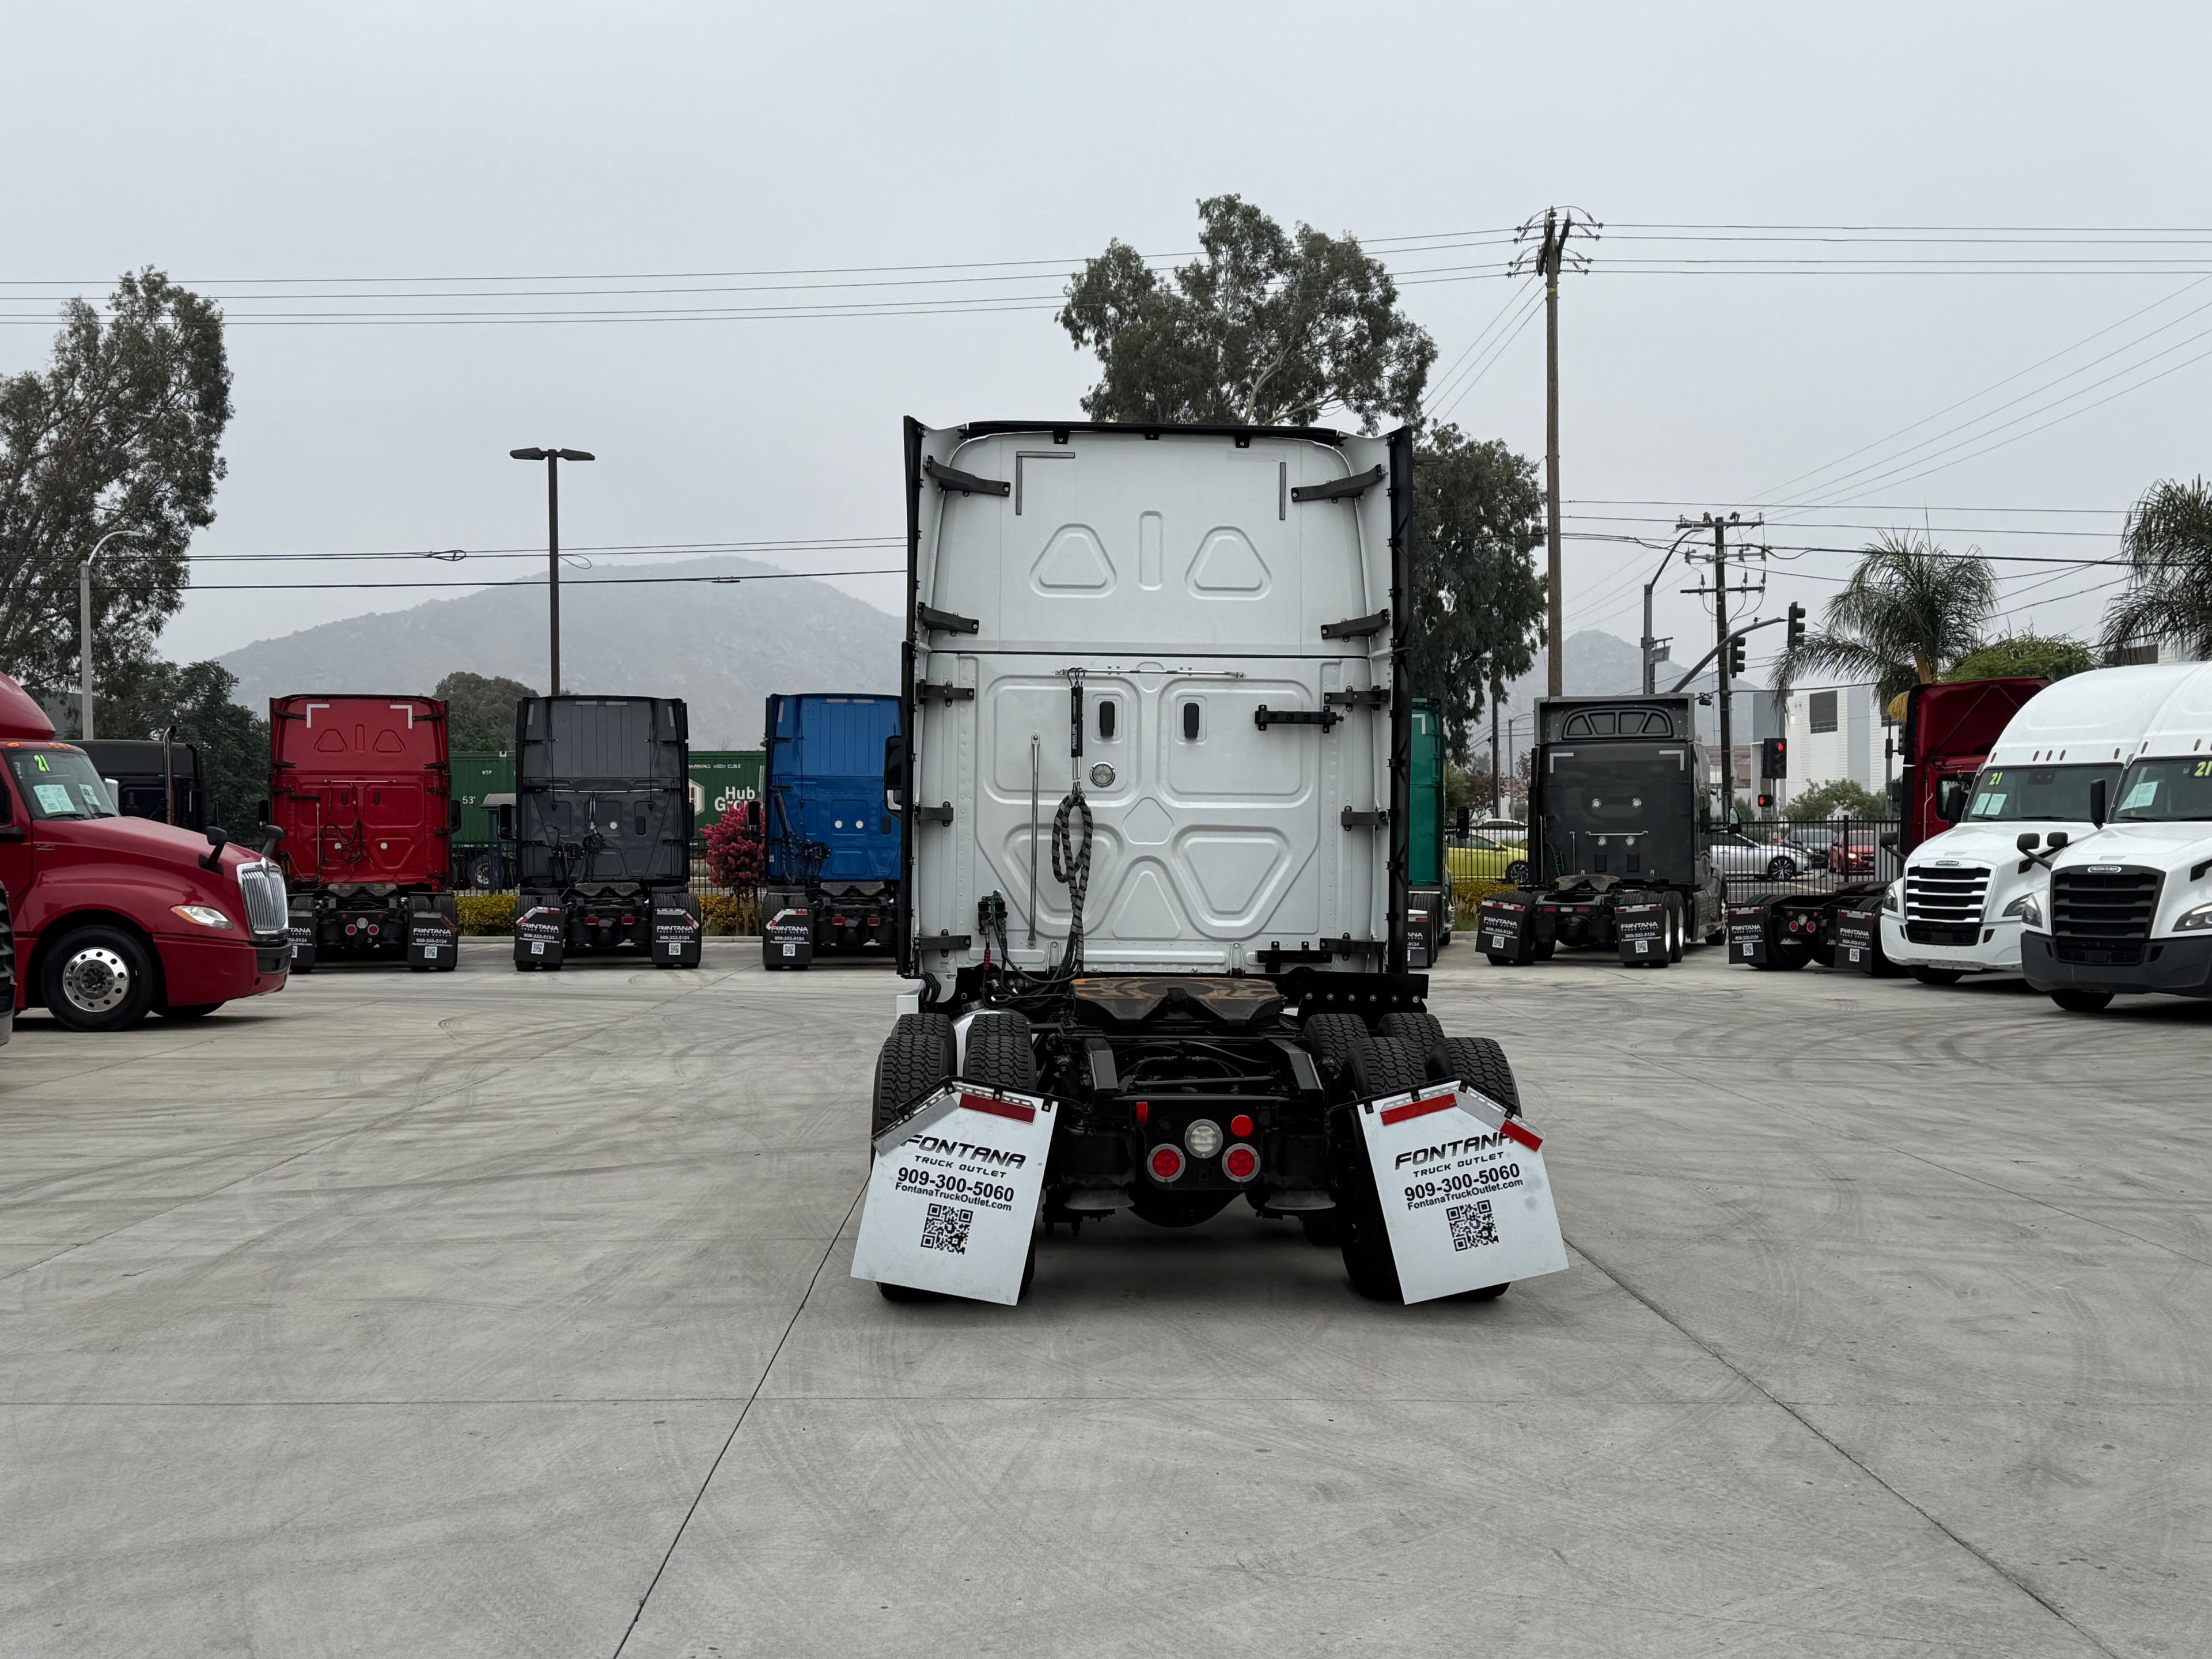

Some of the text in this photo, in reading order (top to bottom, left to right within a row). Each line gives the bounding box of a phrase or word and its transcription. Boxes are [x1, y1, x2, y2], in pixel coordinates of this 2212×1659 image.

[33, 755, 51, 772] 21
[2194, 760, 2212, 777] 21
[1989, 772, 2003, 786] 21
[726, 786, 755, 800] Hub
[521, 923, 559, 931] FONTANA
[900, 1134, 1027, 1169] FONTANA
[915, 1155, 1007, 1178] TRUCK OUTLET
[1413, 1152, 1503, 1177] TRUCK OUTLET
[897, 1167, 1014, 1202] 909-300-5060
[1404, 1163, 1520, 1202] 909-300-5060
[895, 1182, 1012, 1211] FontanaTruckOutlet.com
[1407, 1179, 1524, 1211] FontanaTruckOutlet.com
